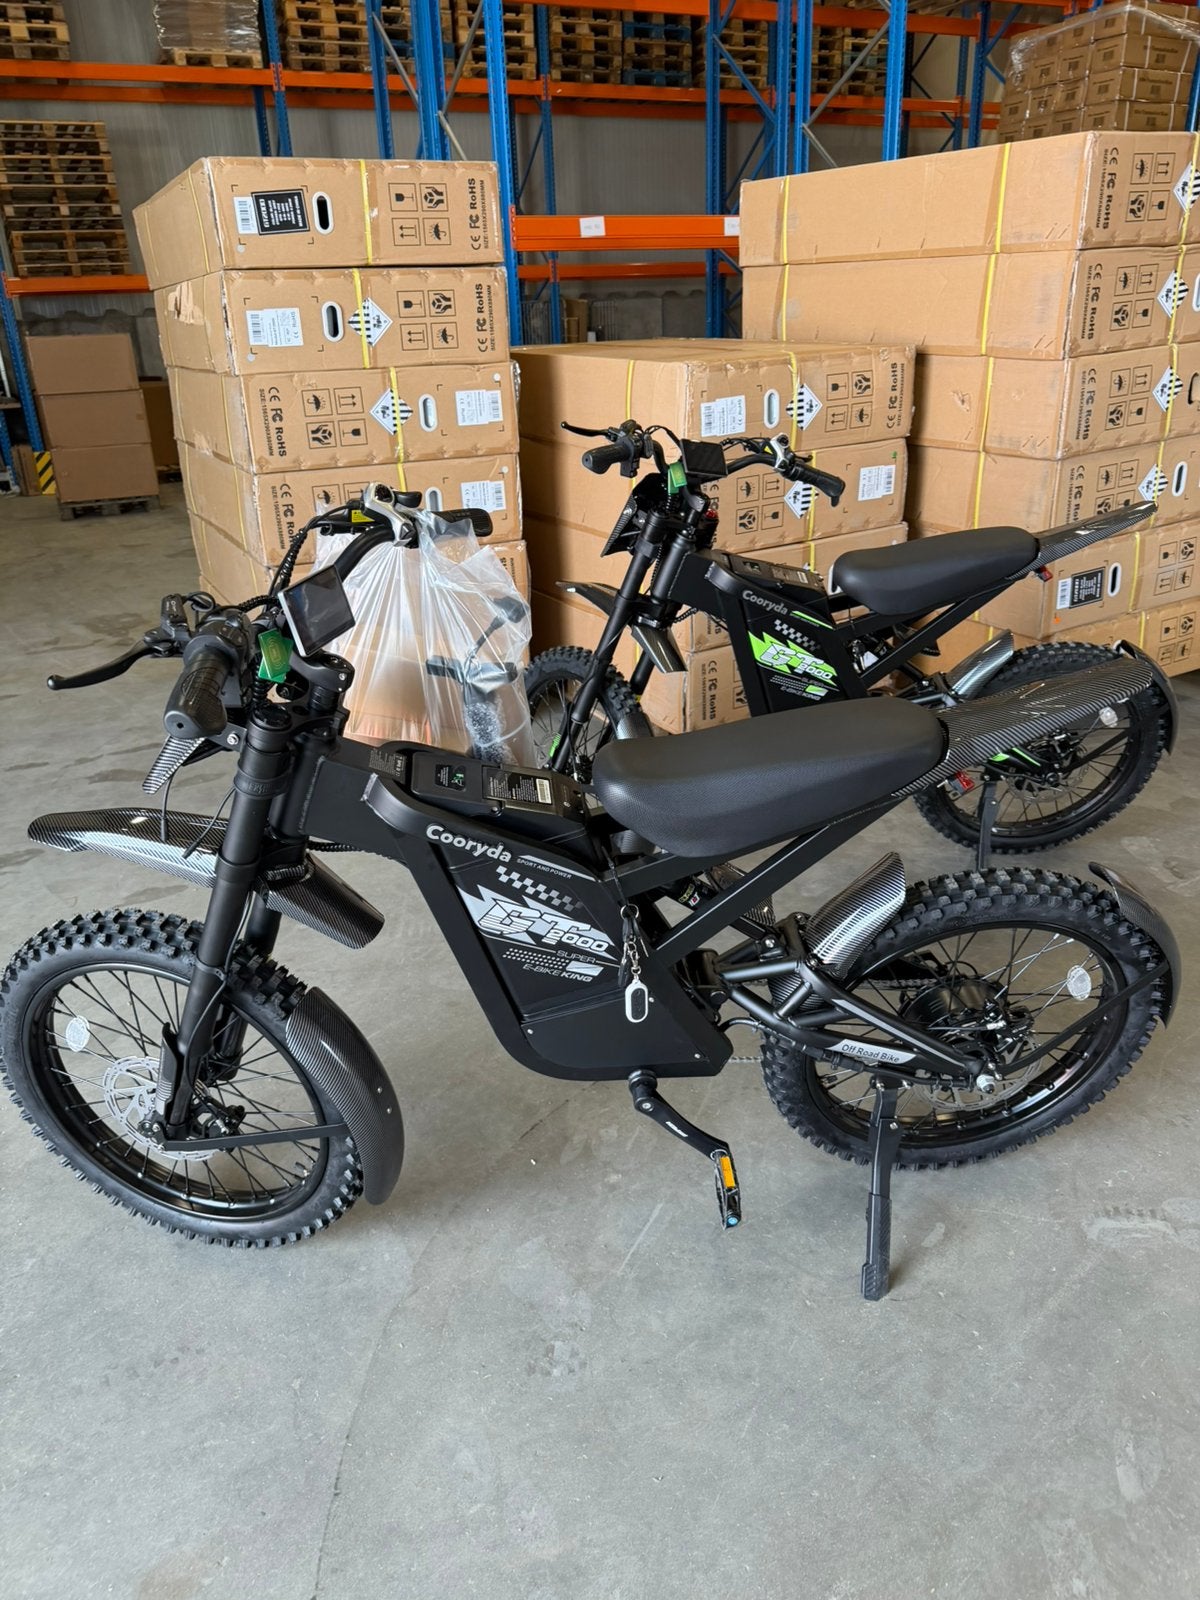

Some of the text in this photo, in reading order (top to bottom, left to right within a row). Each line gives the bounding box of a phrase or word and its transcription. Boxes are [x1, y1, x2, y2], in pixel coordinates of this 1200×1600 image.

[1109, 147, 1119, 165] CE
[467, 178, 477, 210] RoHS
[1102, 194, 1113, 230] RoHS
[470, 235, 481, 251] CE
[1093, 263, 1103, 280] CE
[475, 283, 484, 314] RoHS
[1087, 307, 1097, 340] RoHS
[477, 338, 488, 353] CE
[890, 362, 898, 392] RoHS
[1087, 368, 1097, 384] CE
[268, 386, 281, 402] CE
[275, 426, 287, 457] RoHS
[886, 414, 896, 429] CE
[1082, 409, 1092, 440] RoHS
[280, 483, 292, 498] CE
[742, 589, 788, 616] Cooryda
[708, 660, 718, 675] CE
[794, 663, 833, 679] 2000
[709, 694, 717, 720] RoHS
[426, 825, 512, 863] Cooryda
[516, 858, 572, 879] SPORT AND POWER
[478, 898, 609, 952] GT 2000
[556, 950, 596, 964] SUPER
[522, 963, 593, 982] E-BIKE KING
[841, 1044, 900, 1063] Off Road Bike
